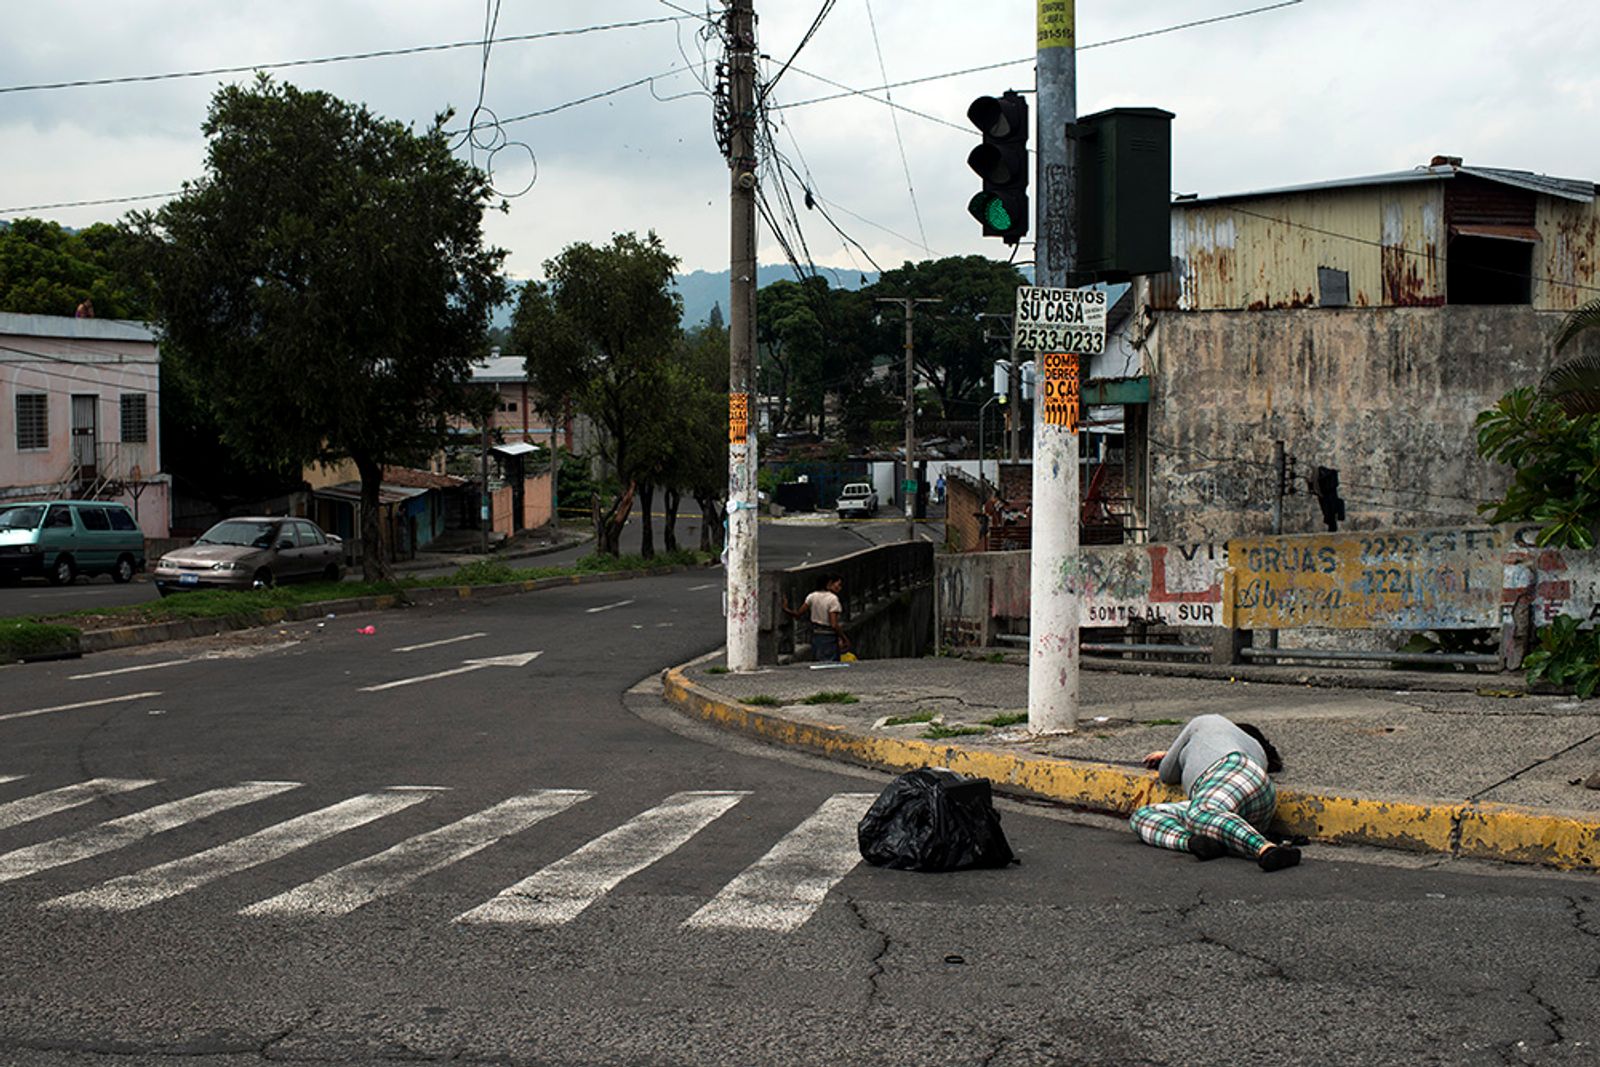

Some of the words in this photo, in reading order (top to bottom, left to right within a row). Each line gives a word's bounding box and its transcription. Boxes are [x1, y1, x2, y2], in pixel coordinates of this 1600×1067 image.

[1020, 288, 1105, 305] VENDEMOS
[1020, 301, 1040, 321] SU
[1044, 301, 1084, 323] CASA
[1017, 329, 1104, 353] 2533-0233
[1248, 546, 1337, 574] GRUAS
[1178, 604, 1214, 624] SUR
